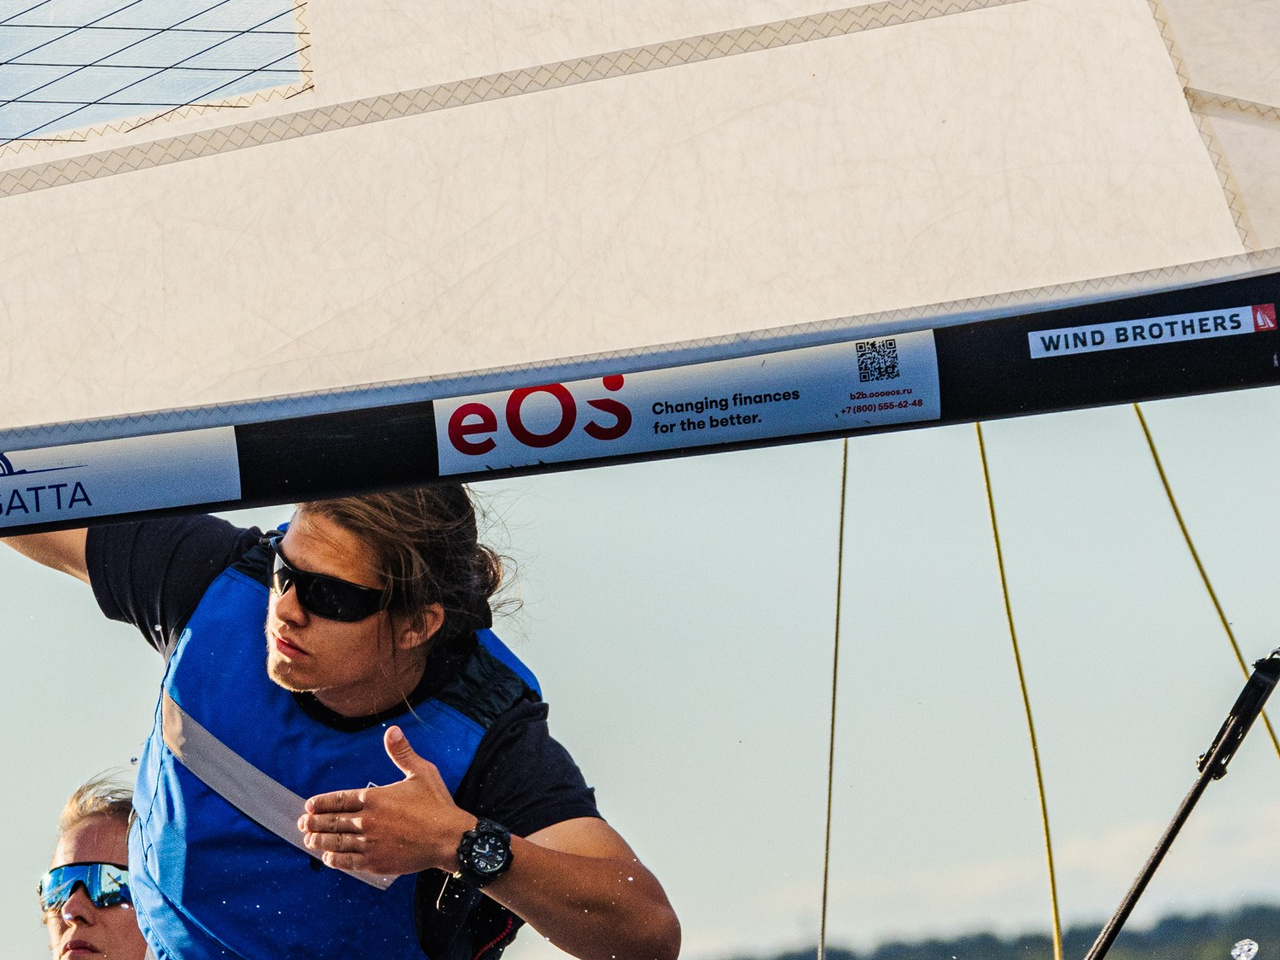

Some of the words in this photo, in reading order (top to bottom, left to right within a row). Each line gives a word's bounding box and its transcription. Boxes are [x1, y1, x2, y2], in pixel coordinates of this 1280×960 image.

[1040, 330, 1105, 352] WIND
[1115, 313, 1242, 343] BROTHERS
[652, 396, 729, 416] Changing
[732, 389, 800, 407] finances
[841, 406, 852, 414] +7
[853, 403, 877, 414] (800)
[878, 399, 924, 411] 555-62-48
[653, 421, 677, 434] for
[680, 417, 706, 431] the
[709, 413, 762, 428] better.
